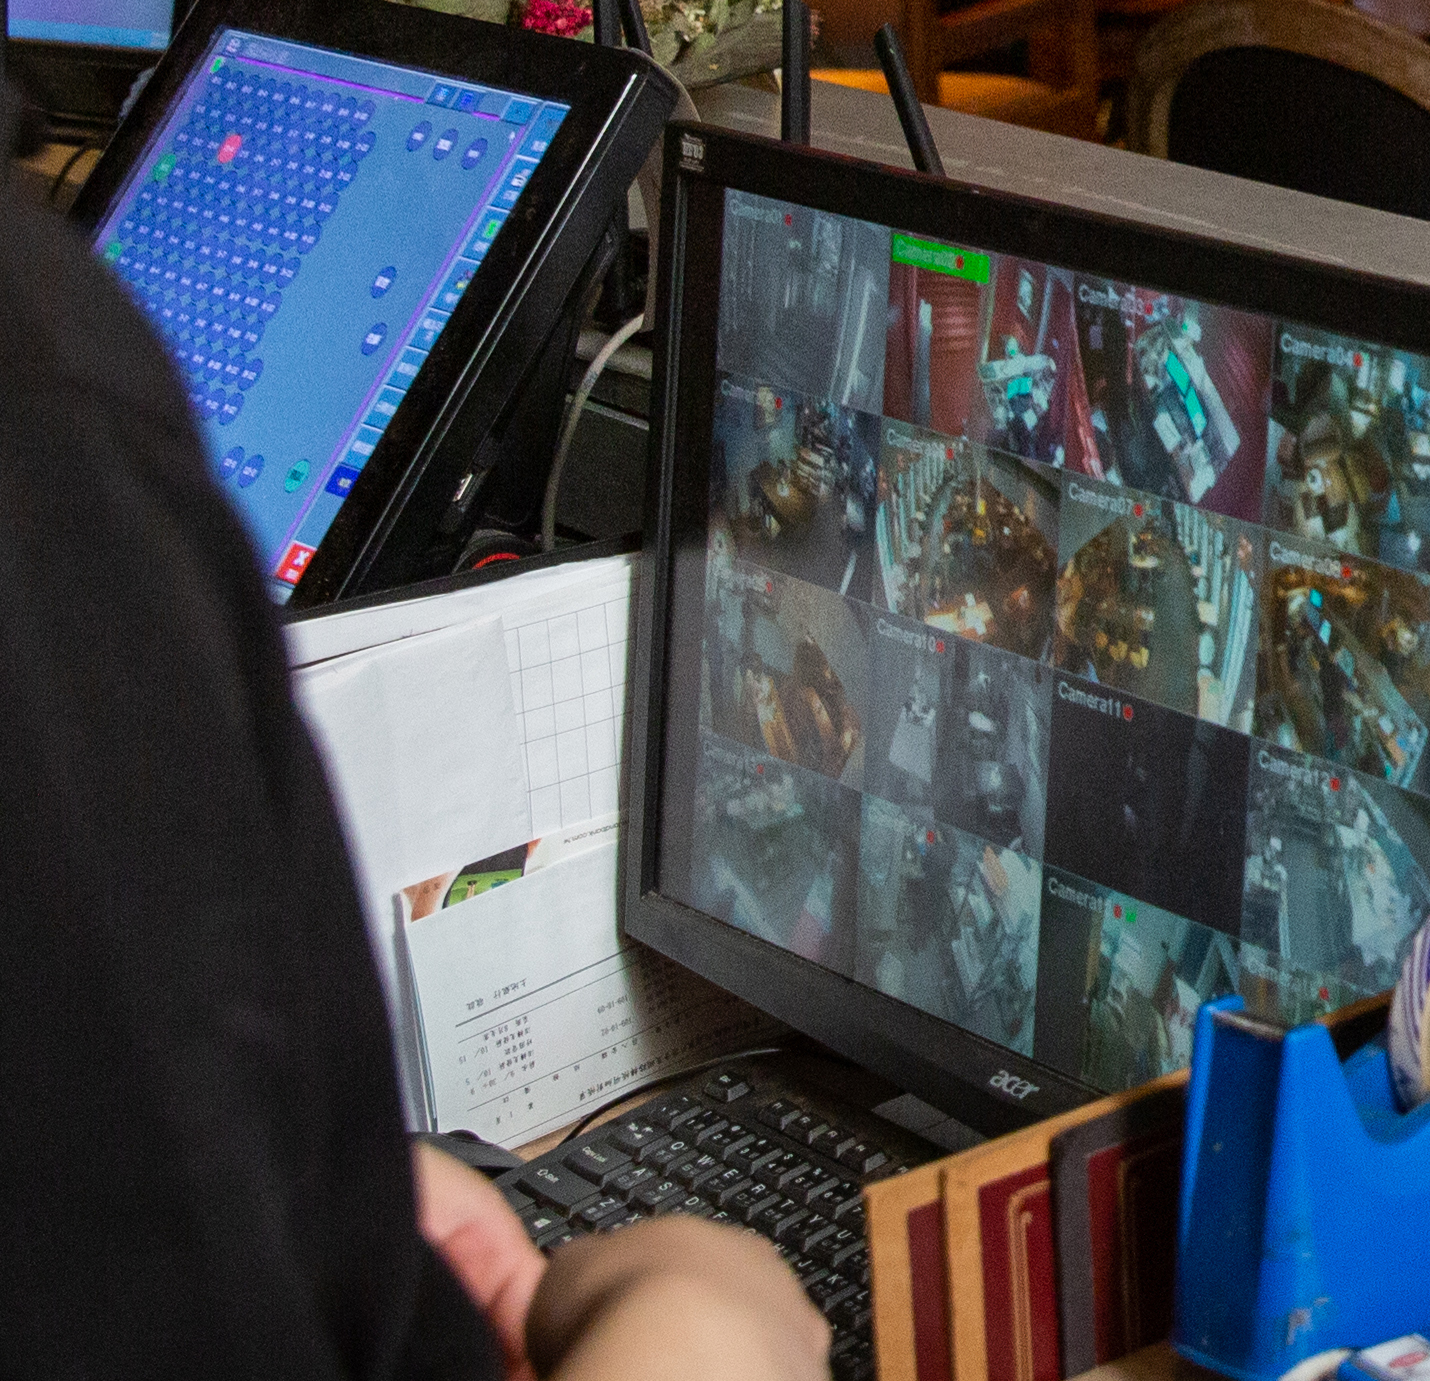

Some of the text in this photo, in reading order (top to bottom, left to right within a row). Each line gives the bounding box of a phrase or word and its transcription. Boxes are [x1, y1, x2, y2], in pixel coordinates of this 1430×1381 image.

[1067, 481, 1134, 516] Camera07
[876, 617, 936, 652] Camera10
[1057, 681, 1122, 719] Camera11
[990, 1070, 1040, 1099] acer
[724, 1168, 739, 1179] E
[659, 1181, 673, 1191] S
[751, 1183, 766, 1194] R
[685, 1196, 699, 1206] D
[780, 1198, 795, 1208] T
[809, 1213, 823, 1224] Y
[837, 1229, 852, 1239] U
